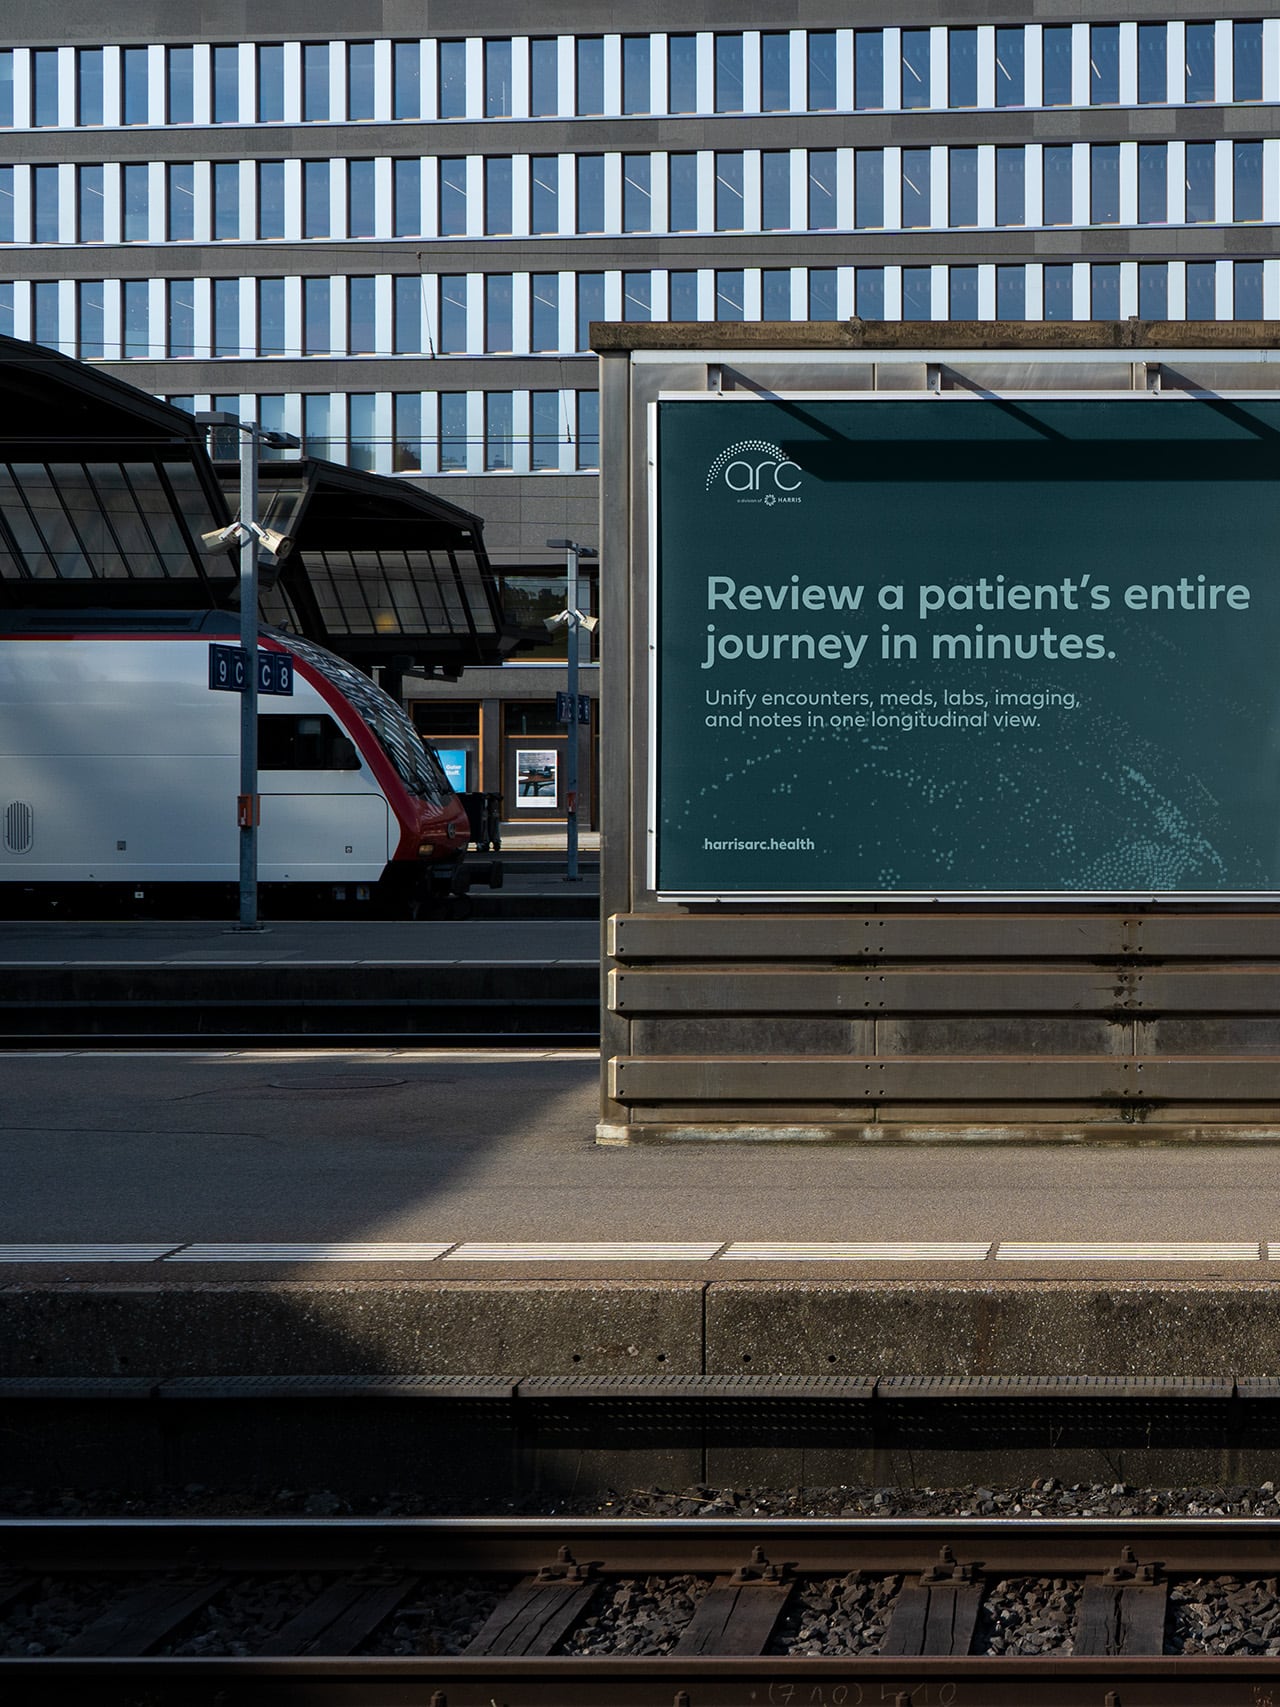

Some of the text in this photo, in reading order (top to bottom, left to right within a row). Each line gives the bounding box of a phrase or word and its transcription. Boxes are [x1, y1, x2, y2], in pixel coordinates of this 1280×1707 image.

[724, 460, 802, 491] arc
[706, 573, 1251, 620] Review a patient's entire
[700, 624, 1117, 670] journey in minutes.
[220, 660, 289, 688] 9 C C 8
[705, 688, 1081, 711] Unify encounters, meds, labs, imaging,
[705, 710, 1041, 732] and notes in one longitudinal view.
[704, 837, 815, 851] harrisarc.health
